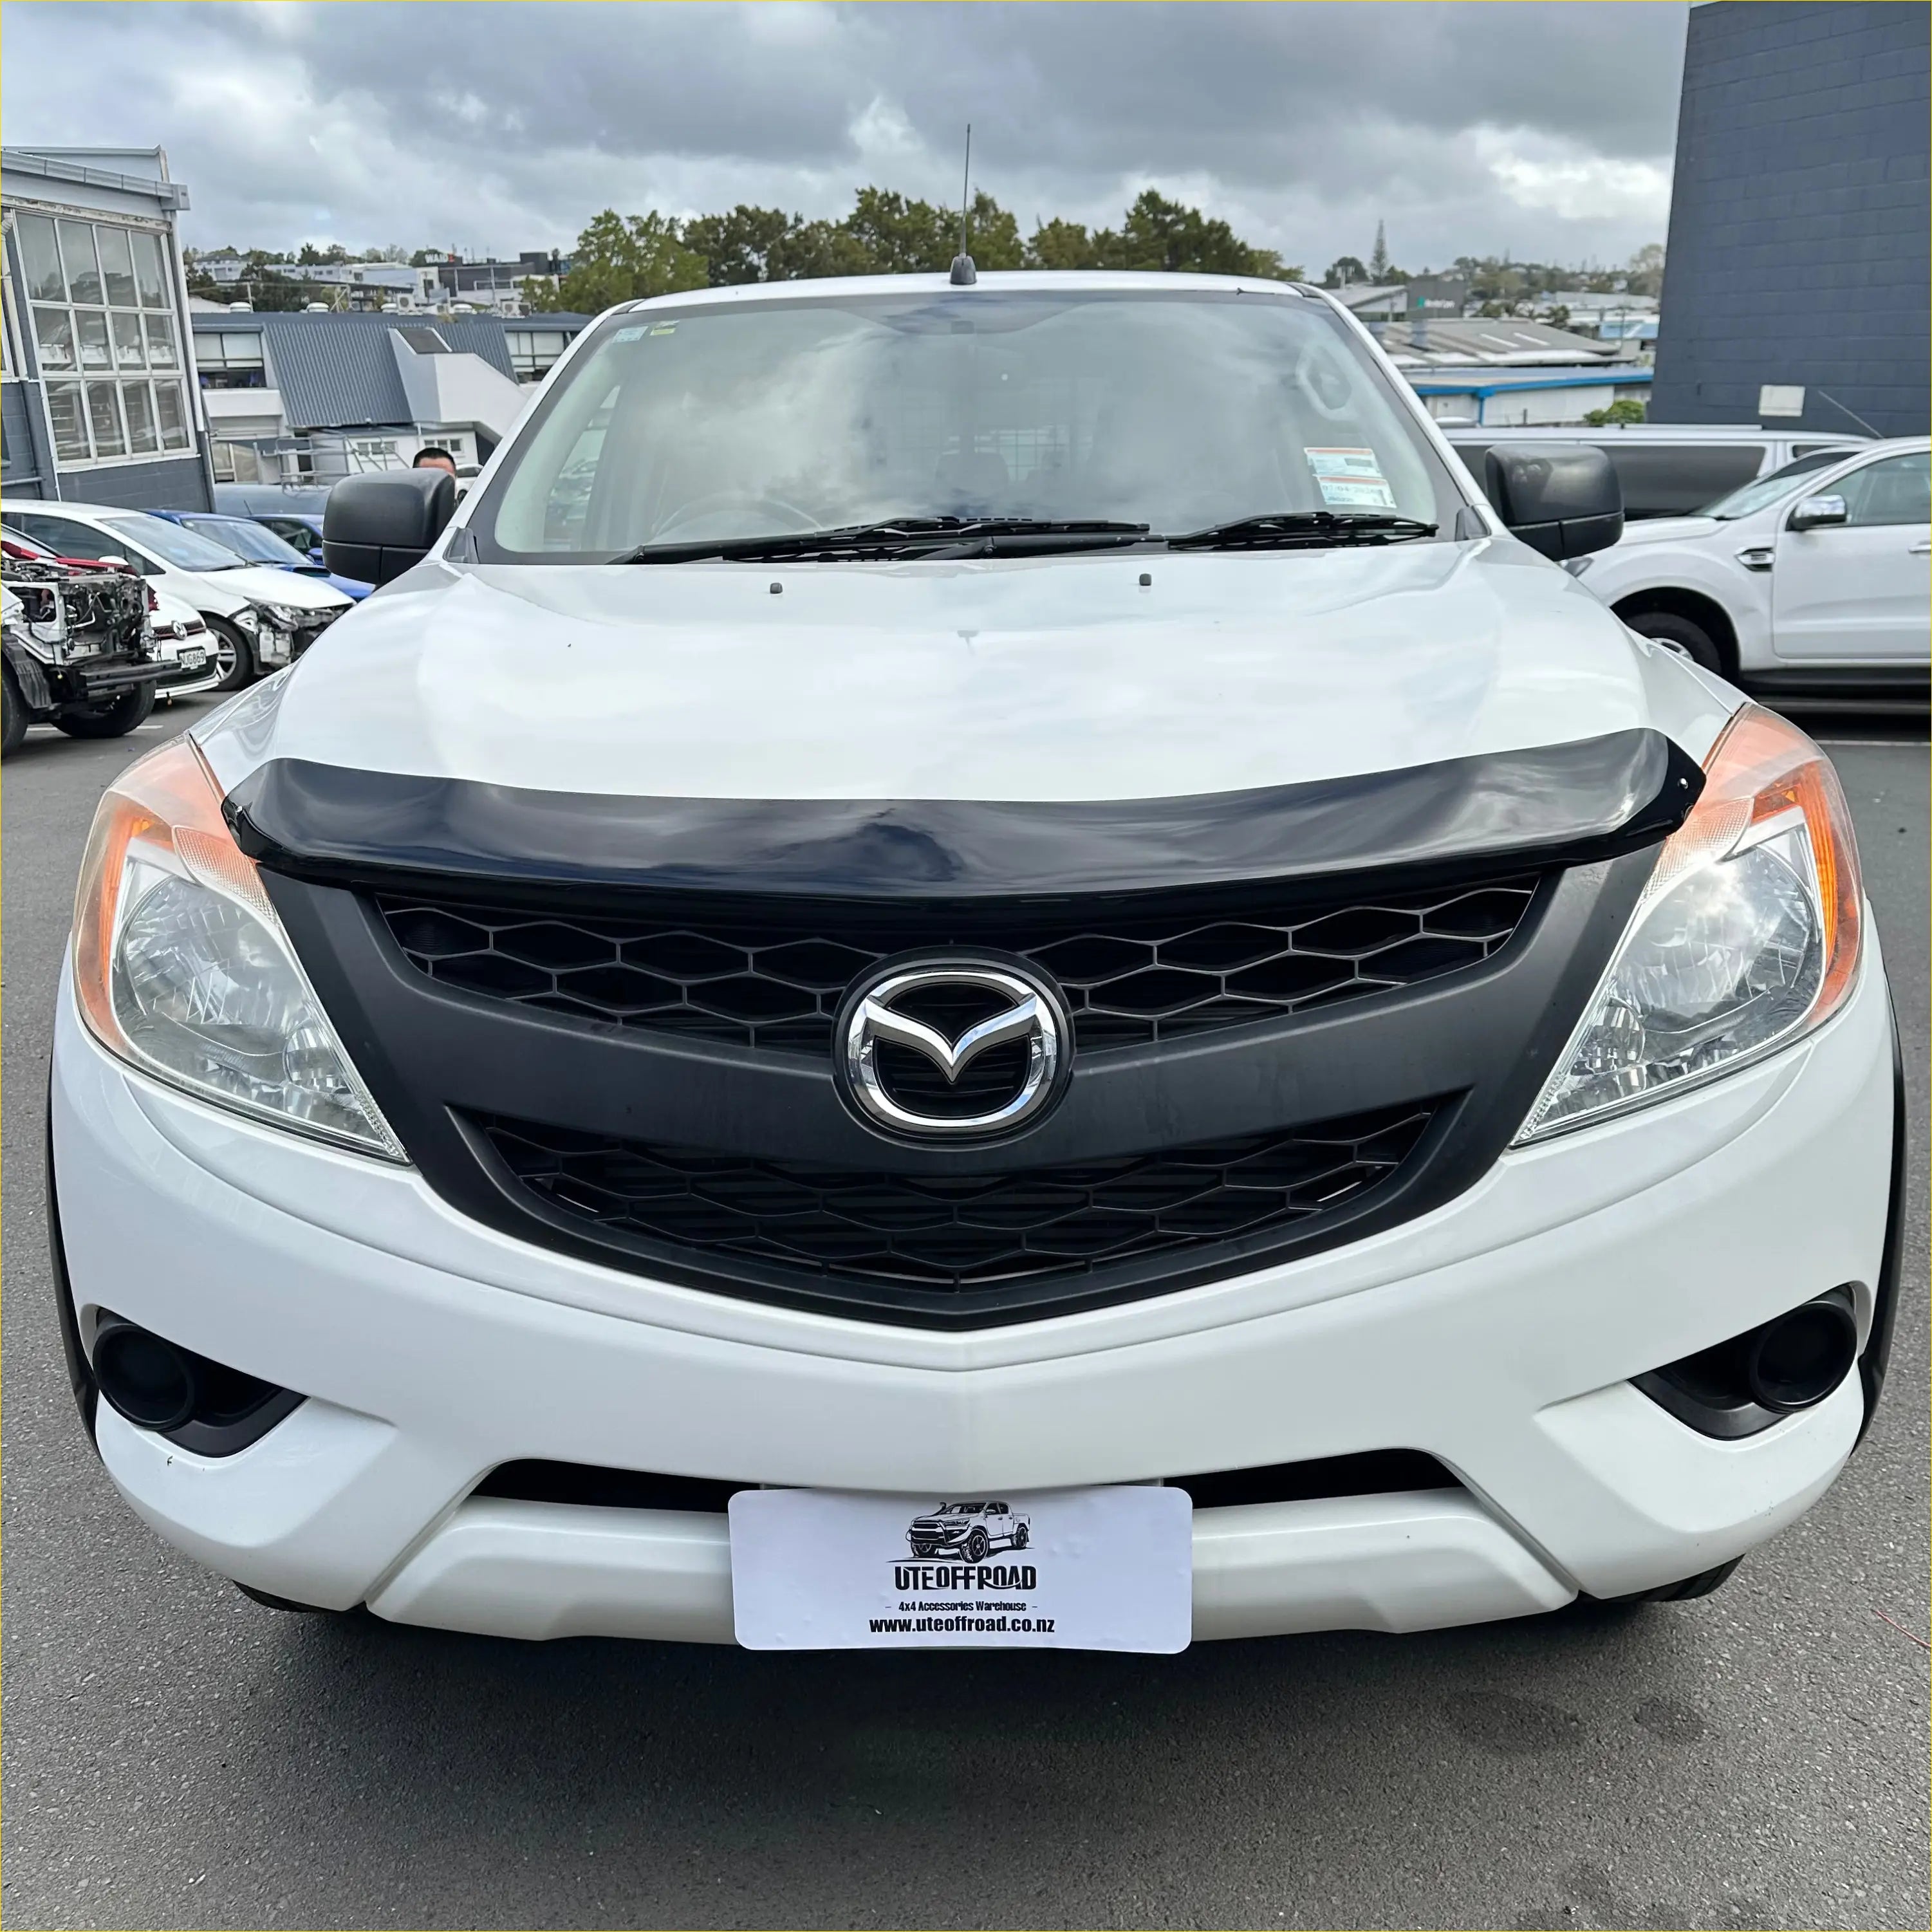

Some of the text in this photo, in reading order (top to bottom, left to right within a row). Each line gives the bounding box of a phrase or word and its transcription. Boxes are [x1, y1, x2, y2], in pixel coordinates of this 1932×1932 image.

[895, 1565, 1037, 1590] UTEOFFROAD
[898, 1601, 1027, 1612] 4x4 Accessories Warehouse
[869, 1616, 1055, 1633] www.uteoffroad.co.nz
